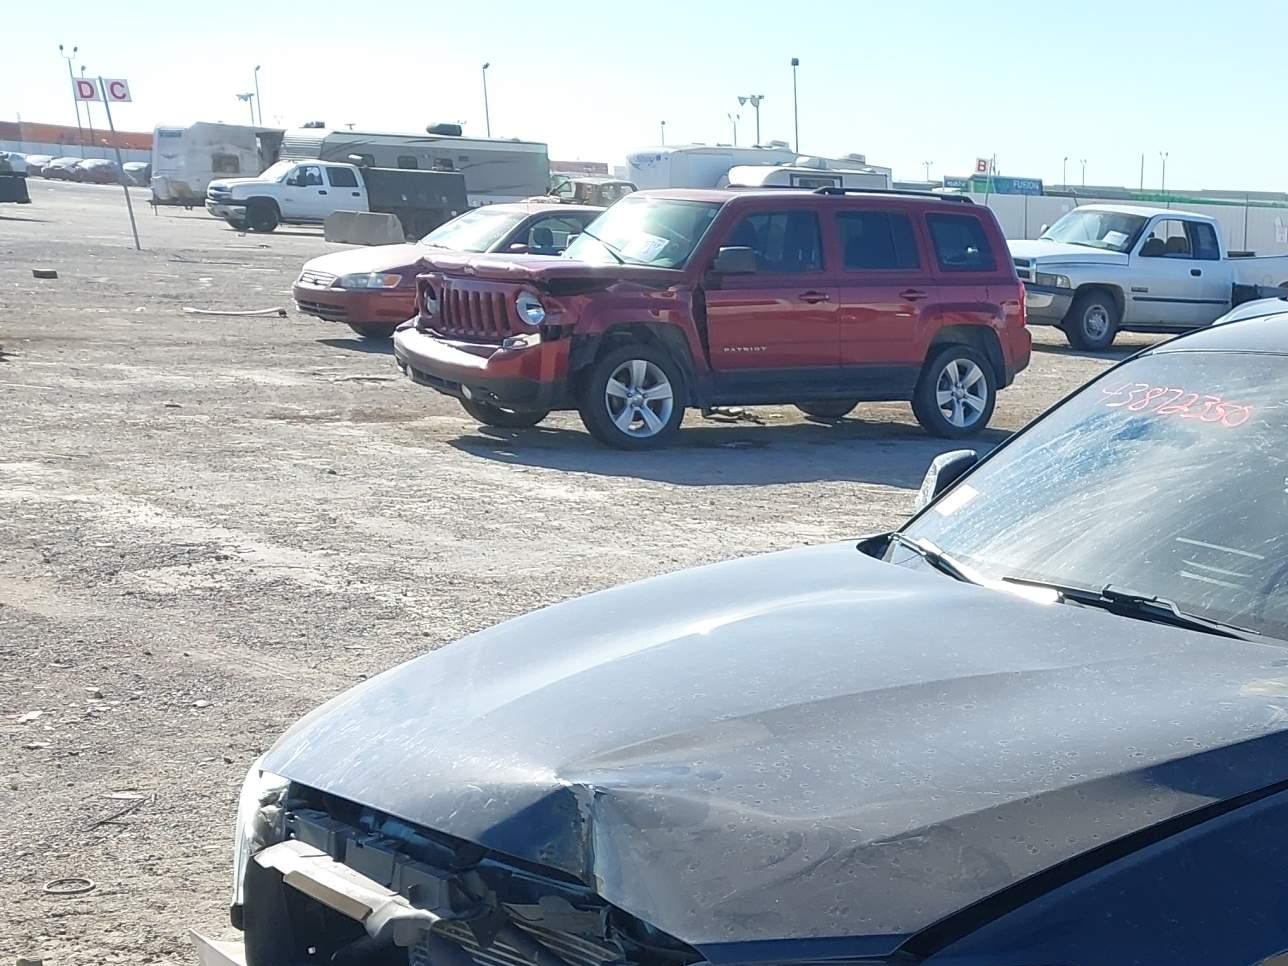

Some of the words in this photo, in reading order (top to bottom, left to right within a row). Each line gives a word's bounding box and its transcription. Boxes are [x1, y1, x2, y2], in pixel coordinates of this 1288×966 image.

[77, 81, 95, 98] D
[110, 81, 126, 99] C
[977, 160, 987, 172] B
